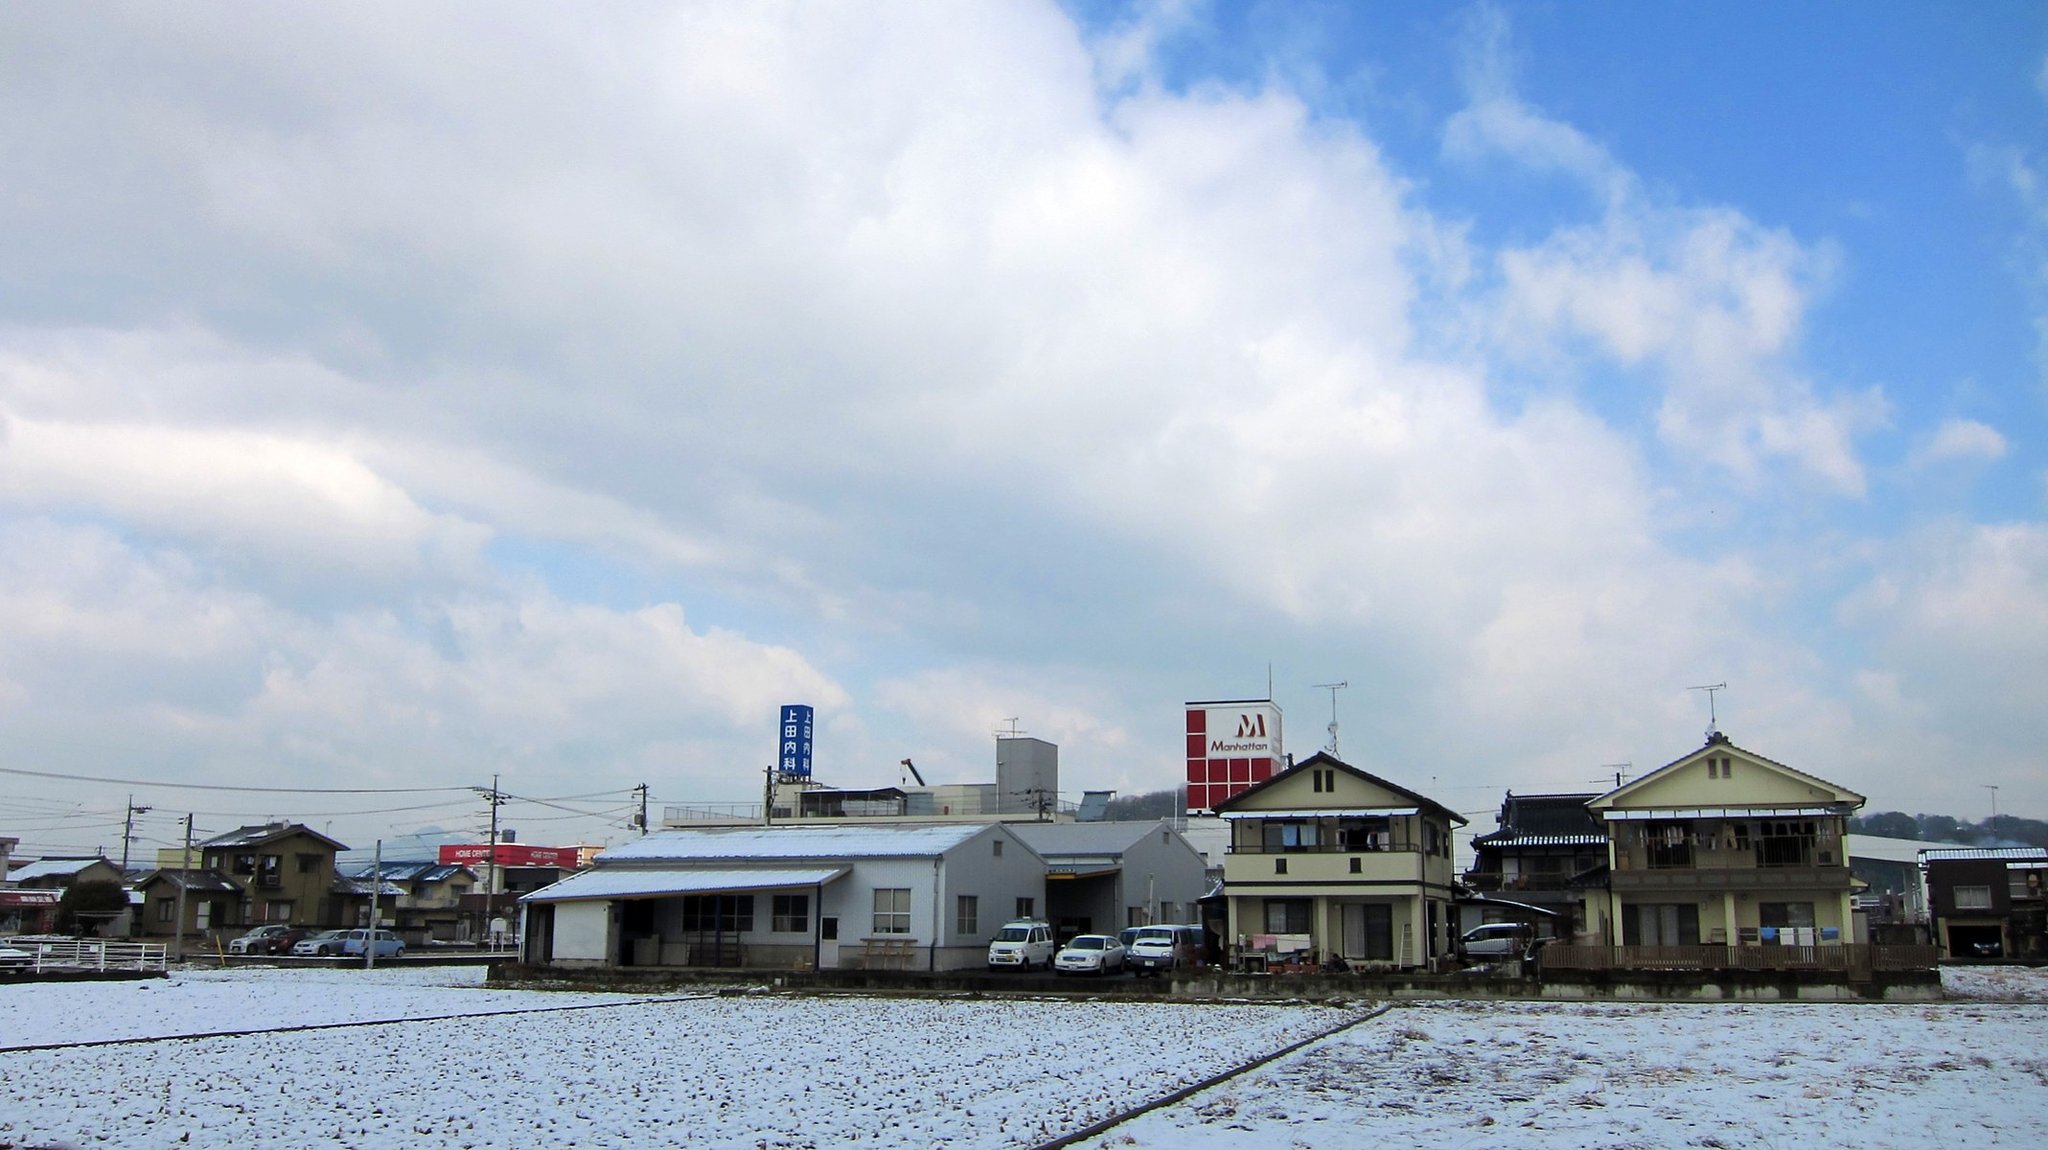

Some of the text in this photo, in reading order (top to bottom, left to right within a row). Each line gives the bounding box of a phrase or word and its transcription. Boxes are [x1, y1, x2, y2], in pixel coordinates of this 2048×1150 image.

[784, 709, 797, 770] 上田内科
[803, 711, 811, 771] 上田内科
[1211, 740, 1268, 752] Manhattan
[455, 850, 471, 858] HOME
